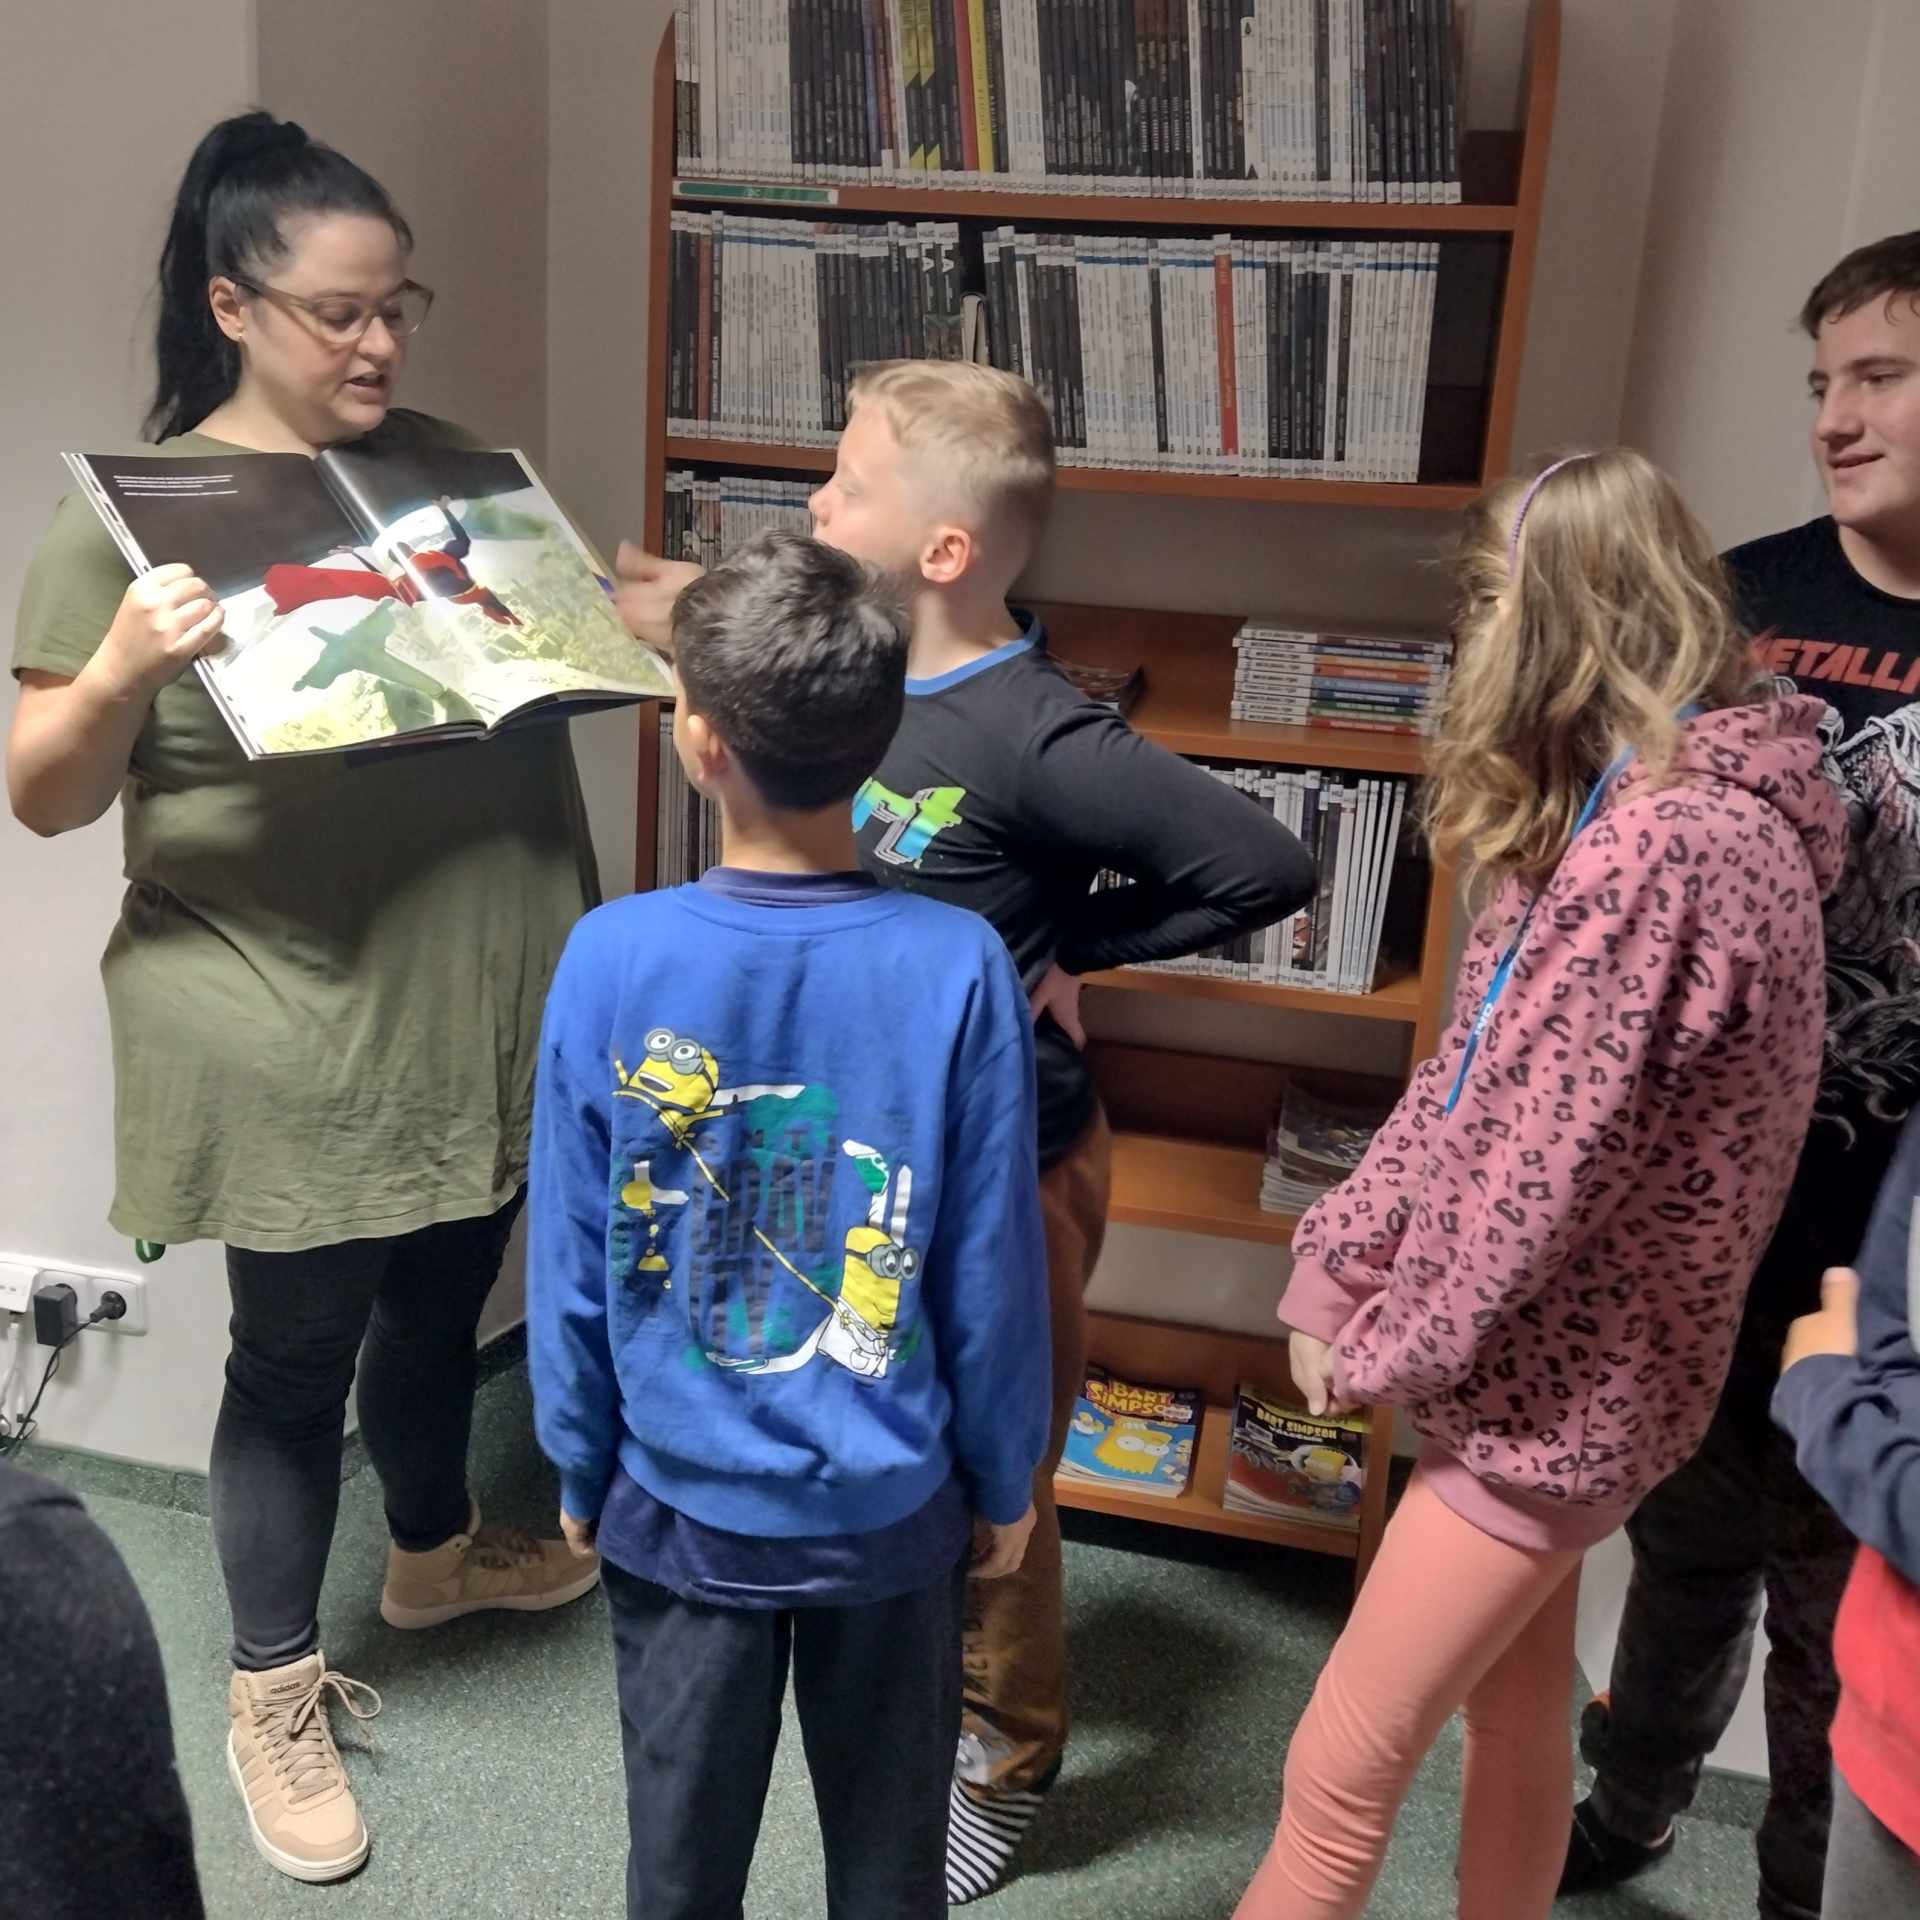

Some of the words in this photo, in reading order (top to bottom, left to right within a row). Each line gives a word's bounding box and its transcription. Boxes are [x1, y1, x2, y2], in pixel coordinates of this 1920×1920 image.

[1087, 1382, 1169, 1414] SIMPSO
[1112, 1381, 1170, 1404] BART
[270, 1681, 301, 1695] adidas
